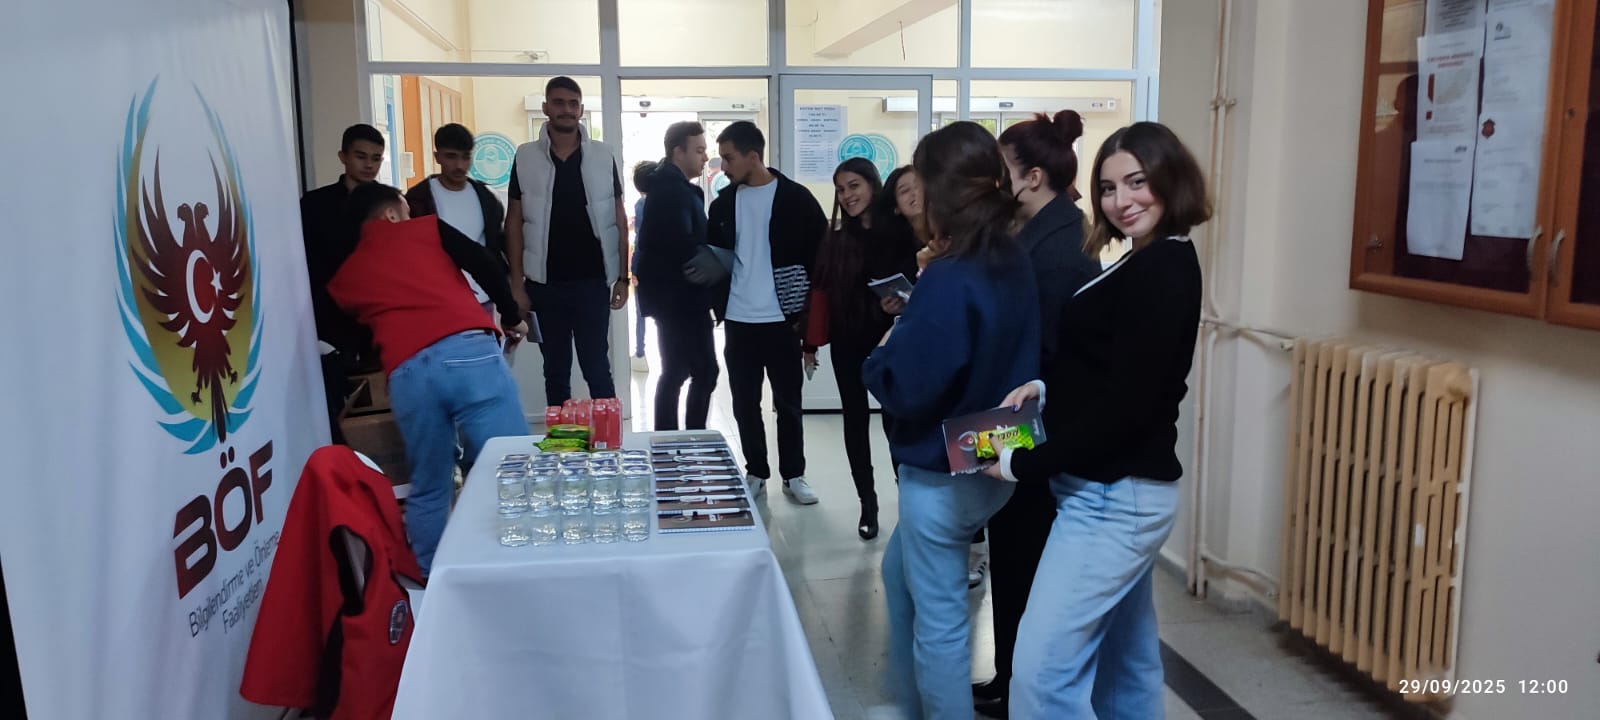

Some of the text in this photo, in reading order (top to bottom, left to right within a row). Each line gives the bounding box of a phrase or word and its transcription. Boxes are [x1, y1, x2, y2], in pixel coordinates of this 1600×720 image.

[173, 440, 273, 600] BÖF
[188, 568, 245, 638] Bilgilendirme
[245, 558, 254, 578] ve
